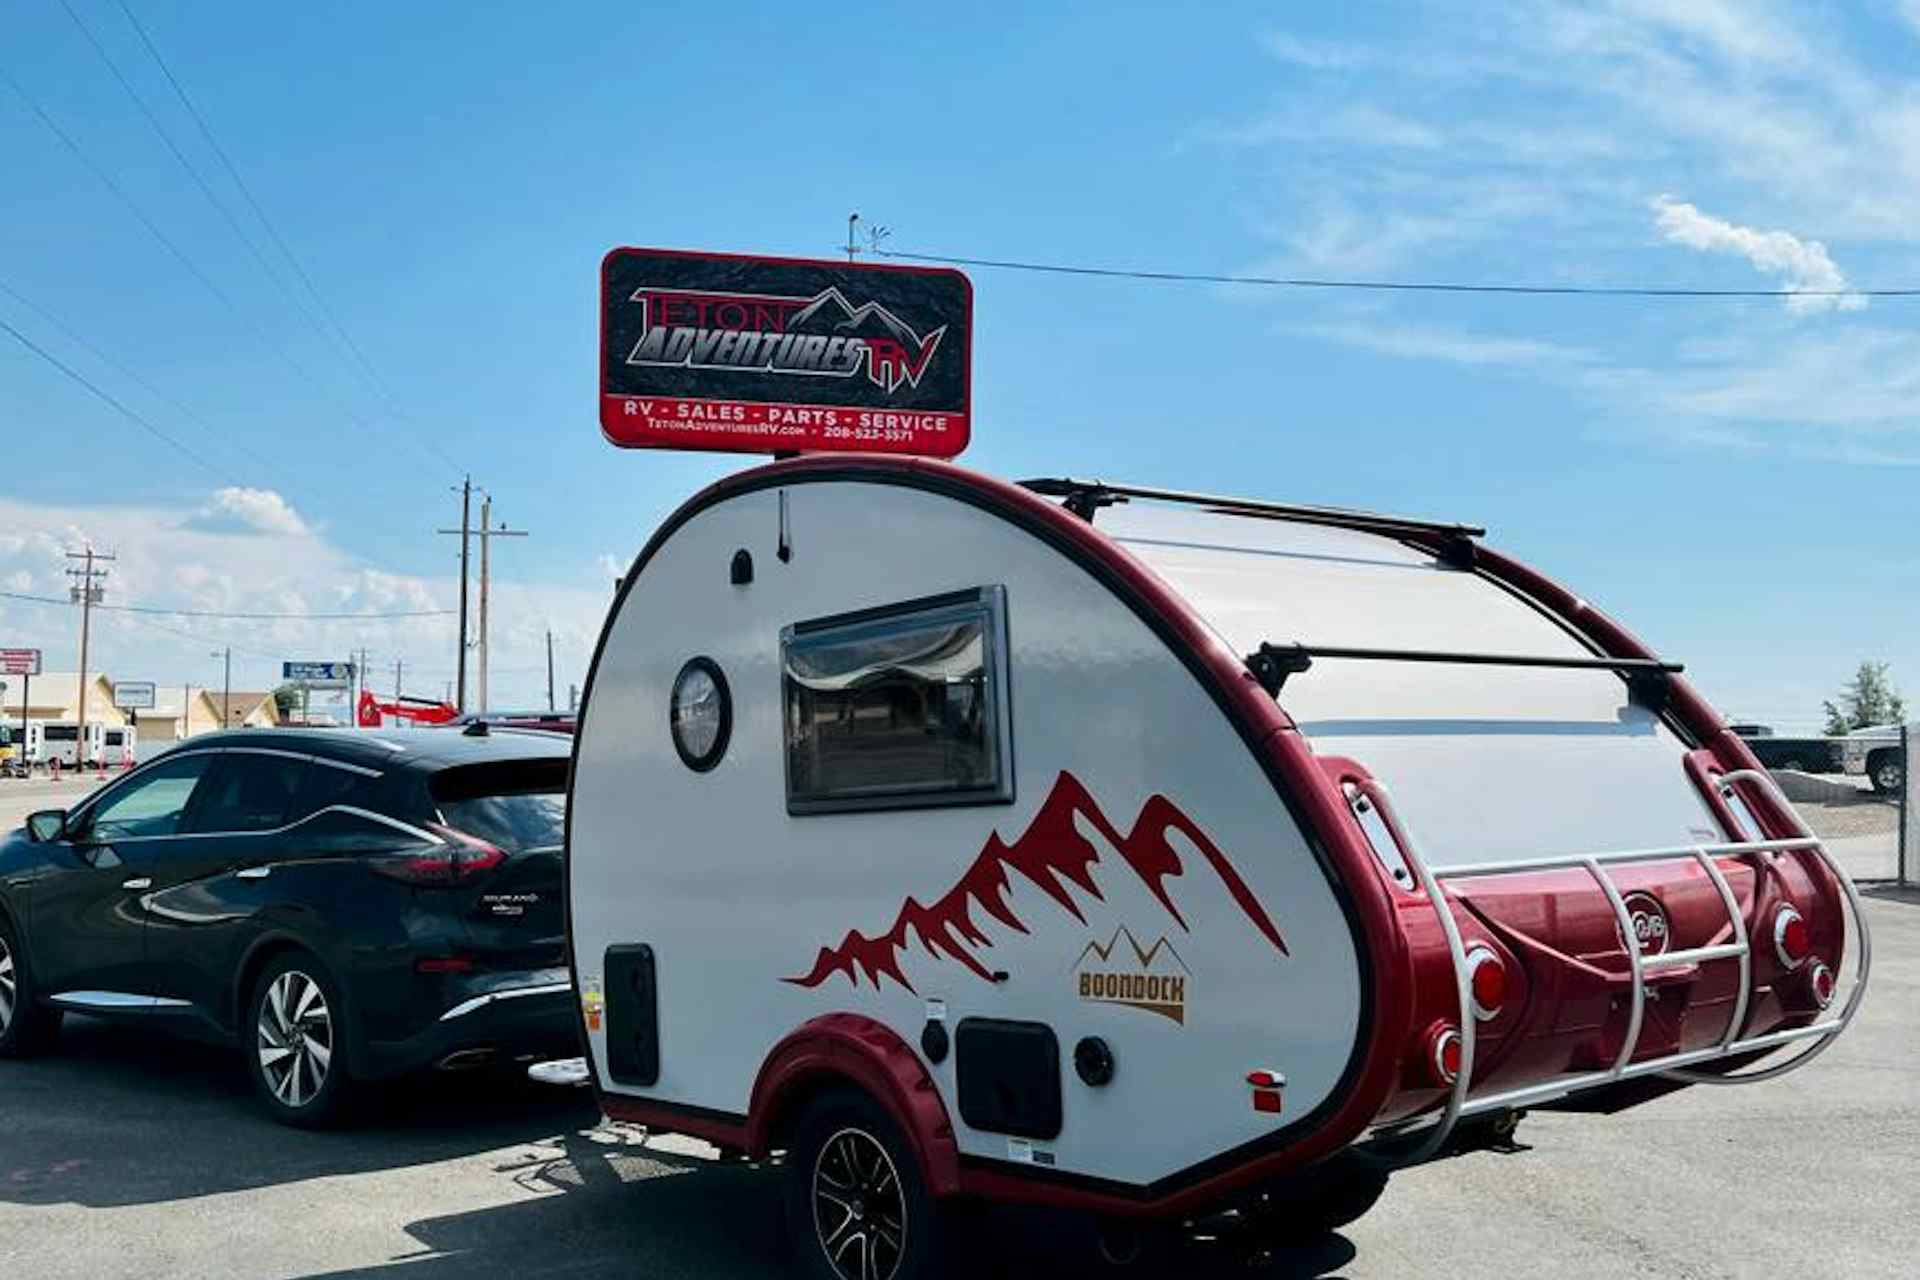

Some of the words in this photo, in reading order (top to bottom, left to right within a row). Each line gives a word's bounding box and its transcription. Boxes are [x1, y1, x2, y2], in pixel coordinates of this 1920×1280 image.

[632, 288, 786, 331] TETON
[634, 326, 865, 372] ADVENTURES
[864, 328, 947, 391] RV
[624, 400, 653, 415] RV
[677, 403, 745, 420] SALES
[768, 408, 837, 426] PARTS
[859, 413, 948, 431] SERVICE
